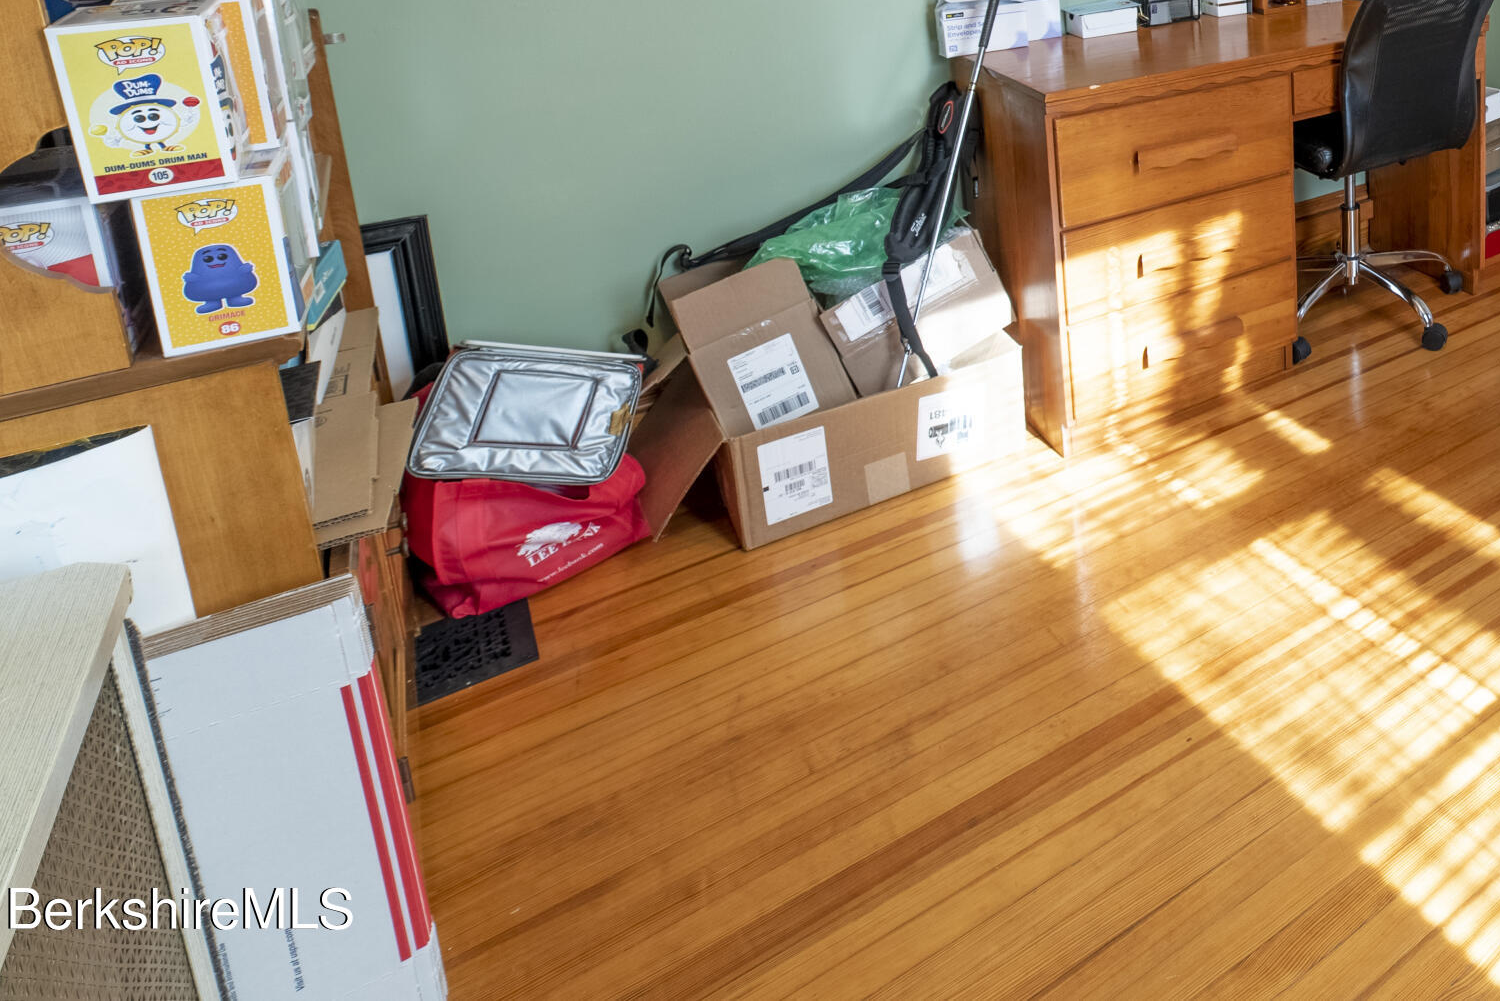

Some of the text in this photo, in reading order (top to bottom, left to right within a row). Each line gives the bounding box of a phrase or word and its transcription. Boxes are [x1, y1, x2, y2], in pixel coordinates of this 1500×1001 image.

[94, 37, 162, 62] POP!
[104, 152, 208, 173] DUM-DUMS DRUM MAN
[152, 171, 169, 181] 105
[174, 200, 235, 223] POP!
[208, 310, 246, 322] GRIMACE
[221, 322, 240, 335] 86
[527, 543, 559, 567] LEE
